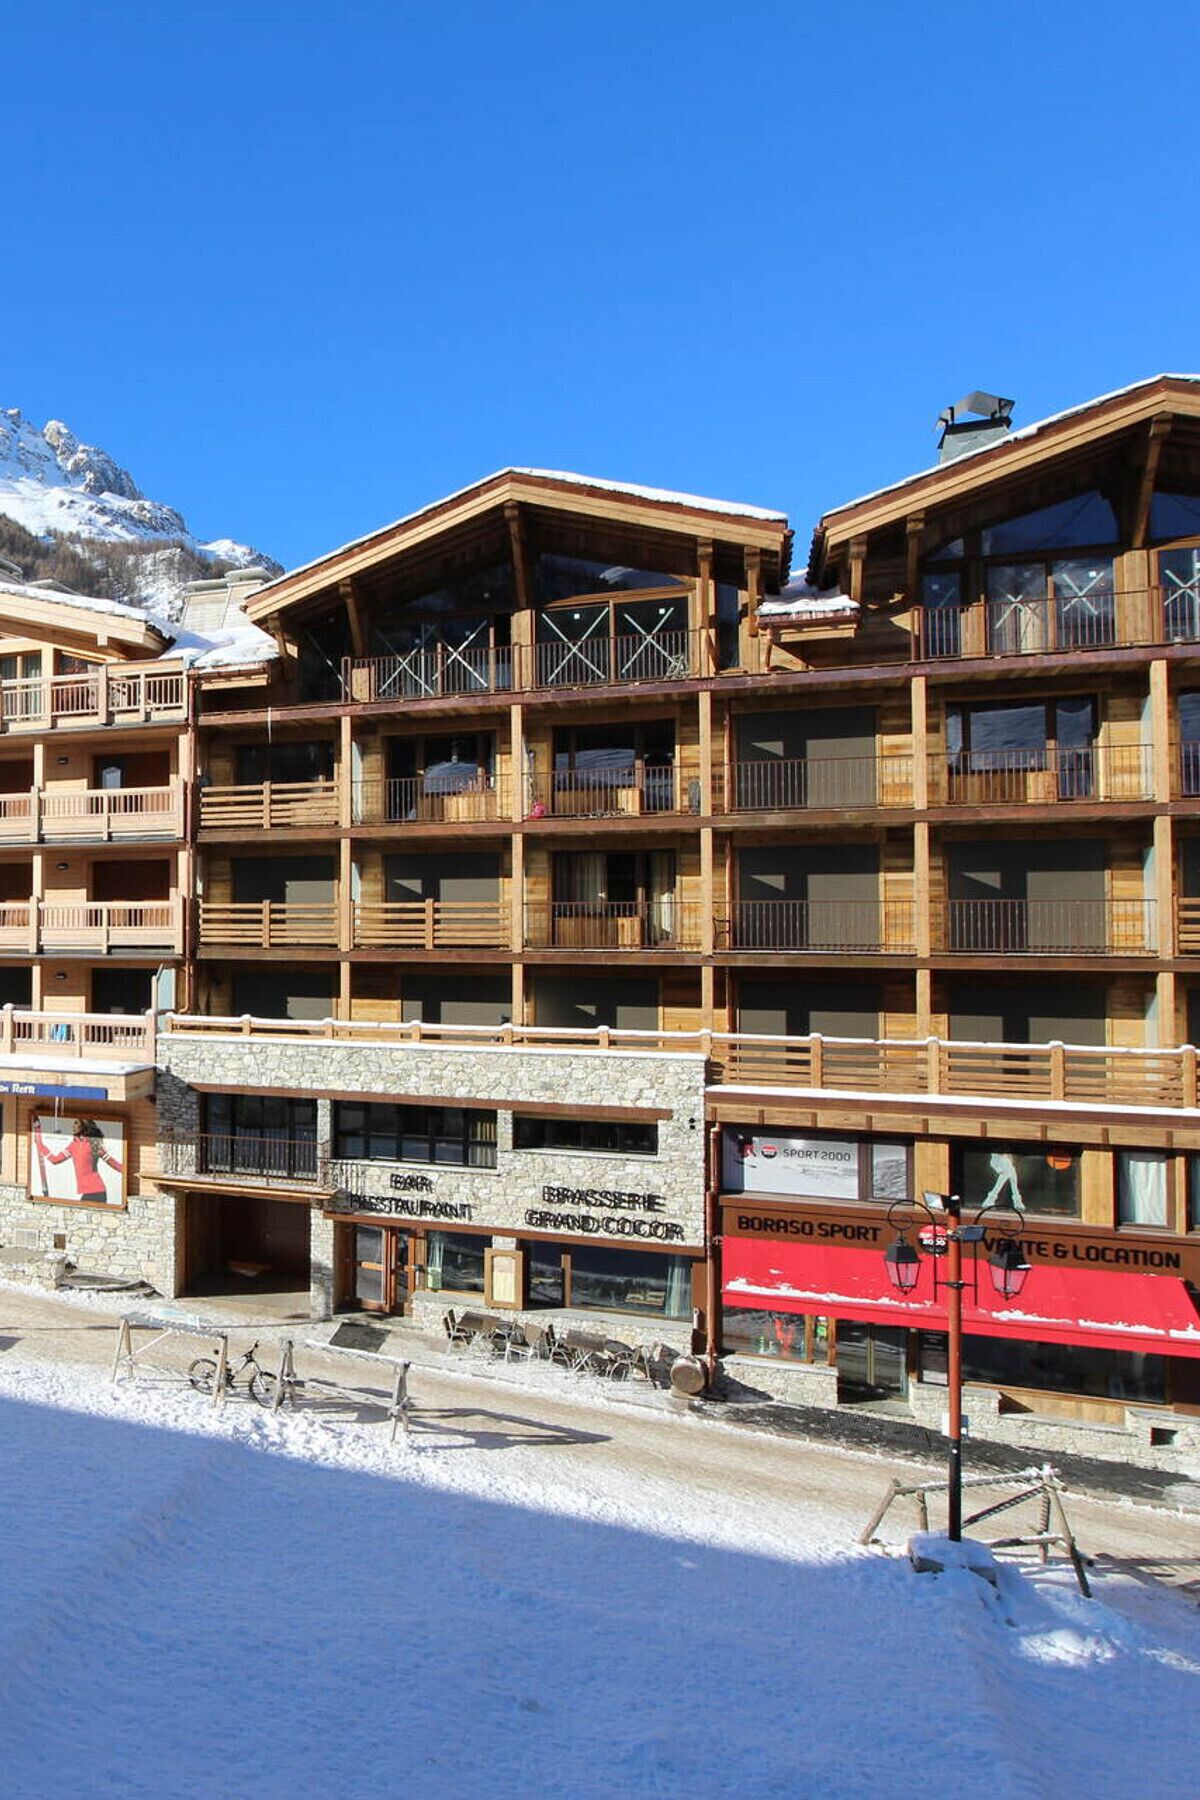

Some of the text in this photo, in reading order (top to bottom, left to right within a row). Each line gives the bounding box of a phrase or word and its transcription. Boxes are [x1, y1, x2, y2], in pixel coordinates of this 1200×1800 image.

[783, 1148, 818, 1160] SPORT
[821, 1151, 851, 1162] 2000
[390, 1173, 433, 1193] BAR
[350, 1193, 477, 1220] RESTAURANT
[542, 1186, 667, 1214] BRASSERIE
[524, 1209, 601, 1233] GRAND
[738, 1215, 882, 1242] BORASO SPORT
[1053, 1243, 1069, 1258] &
[1073, 1244, 1181, 1269] LOCATION
